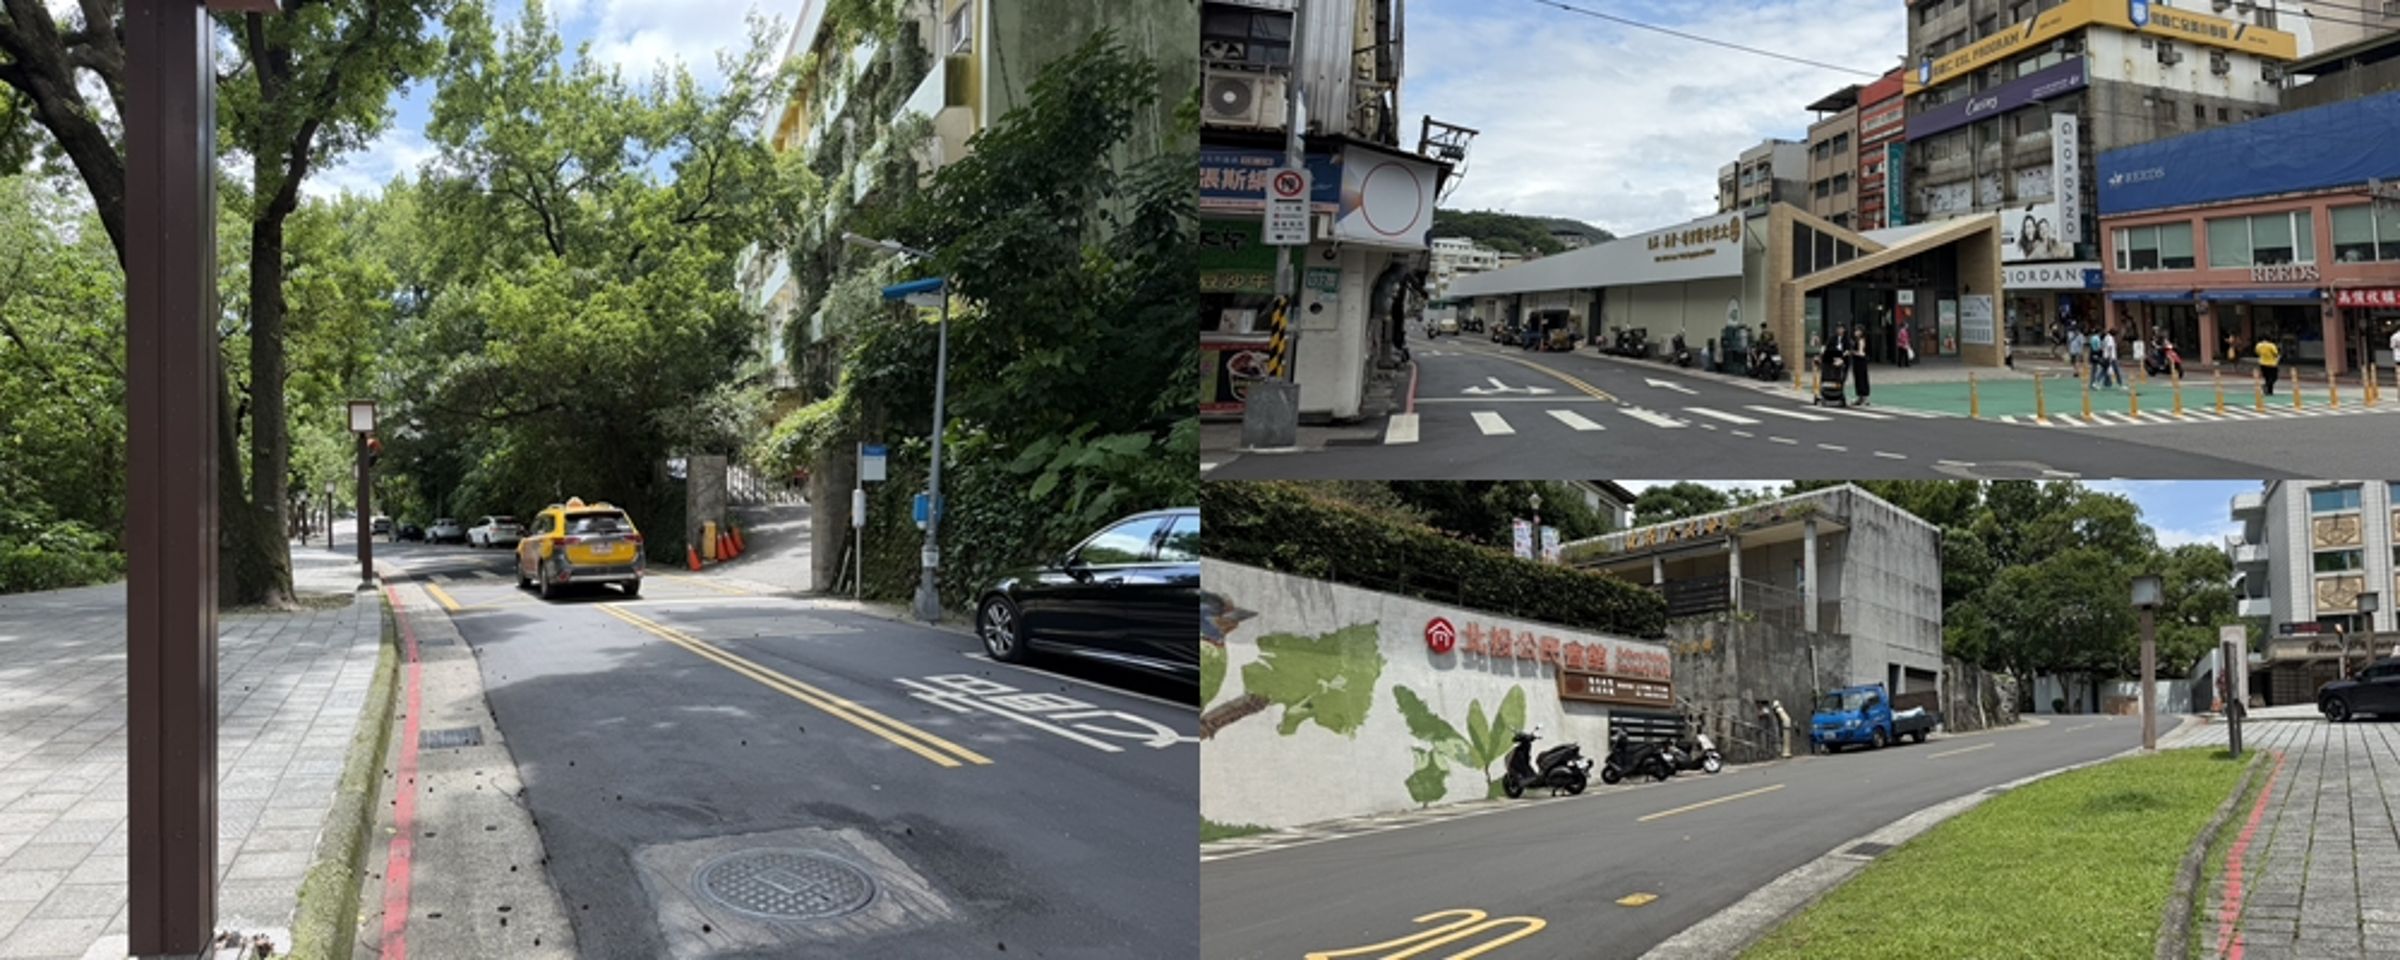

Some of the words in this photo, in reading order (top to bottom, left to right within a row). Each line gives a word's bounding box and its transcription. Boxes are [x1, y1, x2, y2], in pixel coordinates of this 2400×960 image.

[2061, 121, 2076, 235] GIORDANO
[2252, 265, 2320, 282] REEDS
[1460, 621, 1608, 671] 北投公民會館
